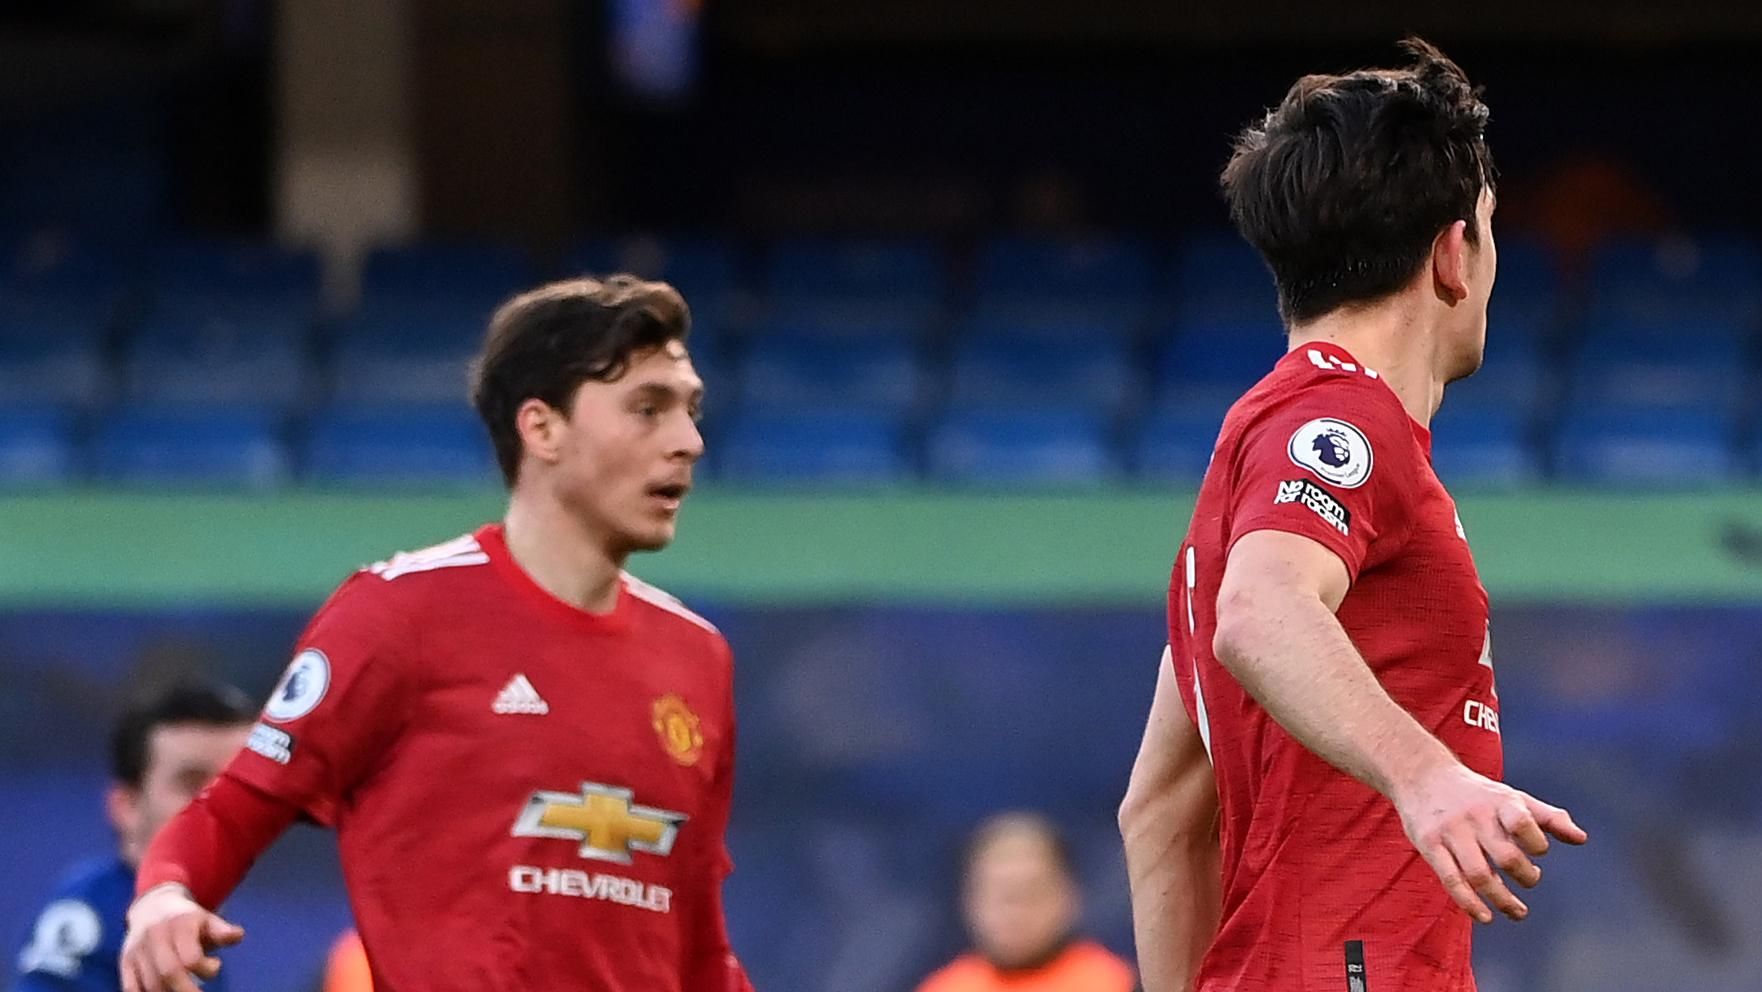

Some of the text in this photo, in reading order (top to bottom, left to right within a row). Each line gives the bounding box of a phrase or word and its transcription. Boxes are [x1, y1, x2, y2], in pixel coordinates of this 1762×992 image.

[1279, 480, 1345, 521] No room
[509, 865, 673, 913] CHEVROLET
